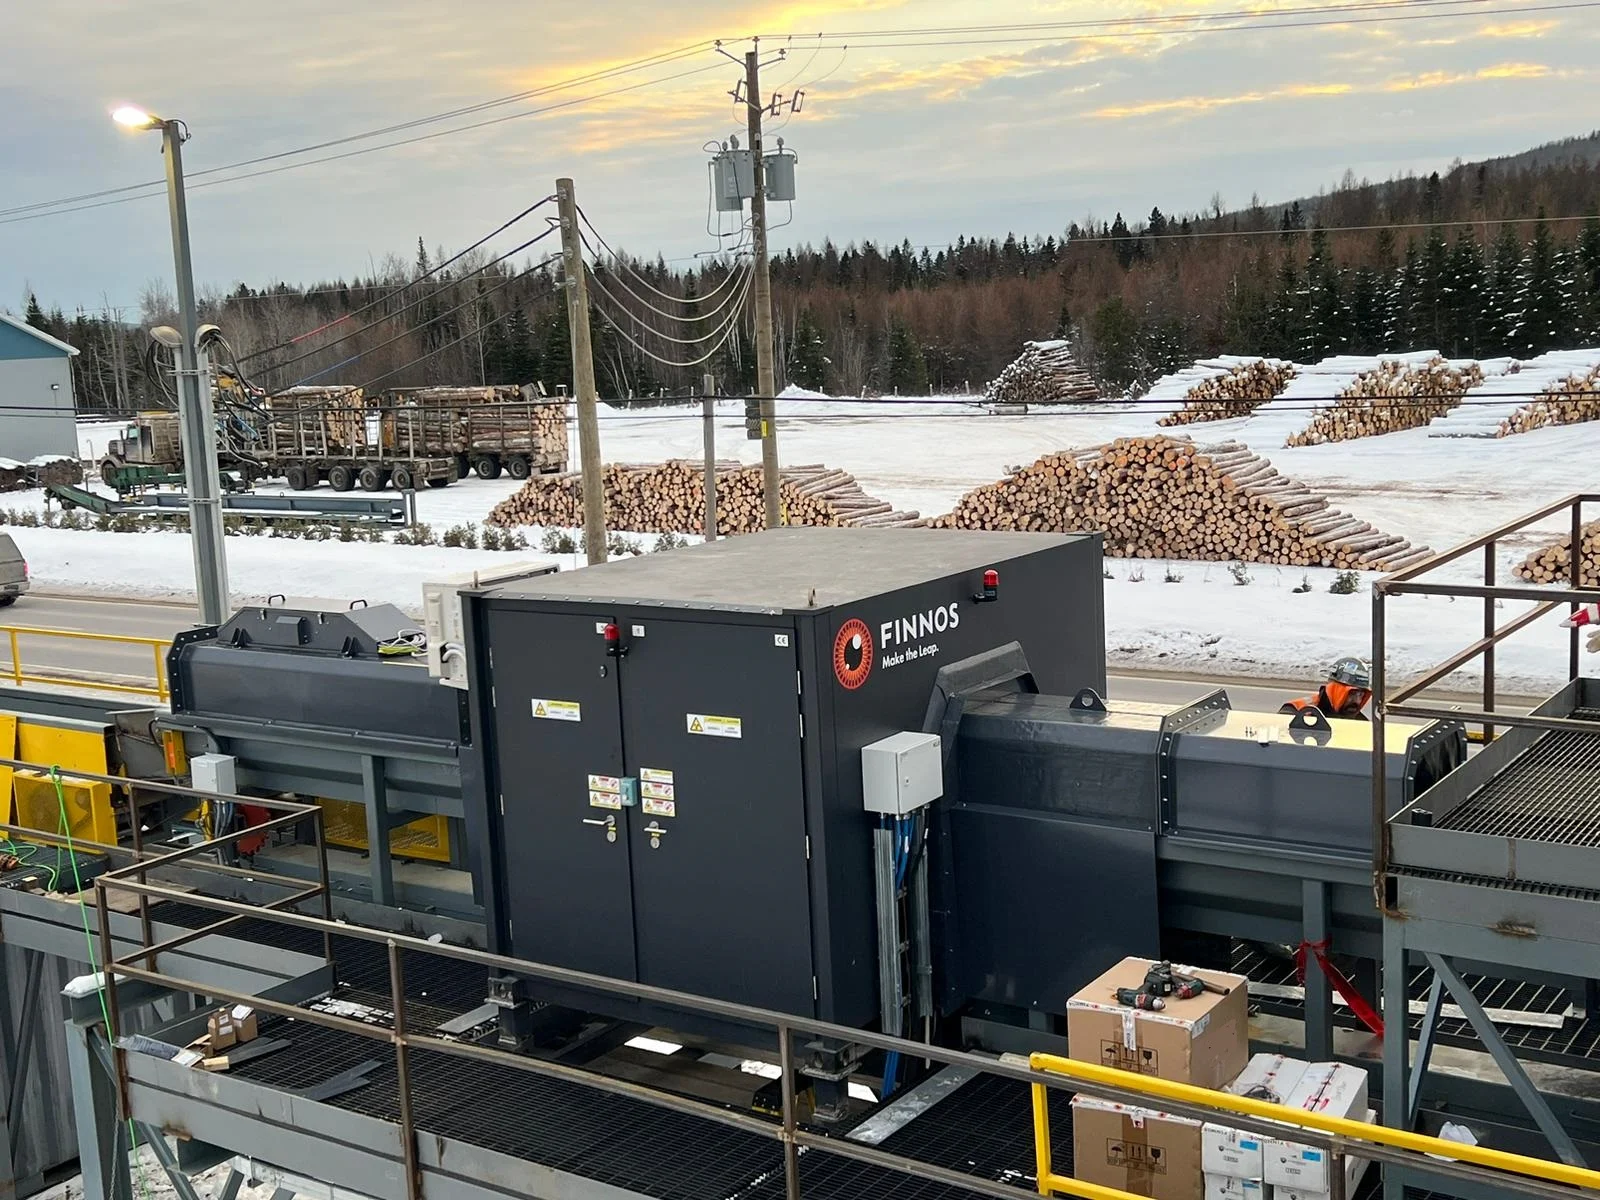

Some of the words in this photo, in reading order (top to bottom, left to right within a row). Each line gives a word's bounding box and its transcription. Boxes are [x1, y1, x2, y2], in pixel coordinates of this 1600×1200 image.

[880, 602, 959, 649] FINNOS
[882, 652, 904, 669] Make
[905, 647, 918, 661] the
[919, 644, 939, 657] Leap.
